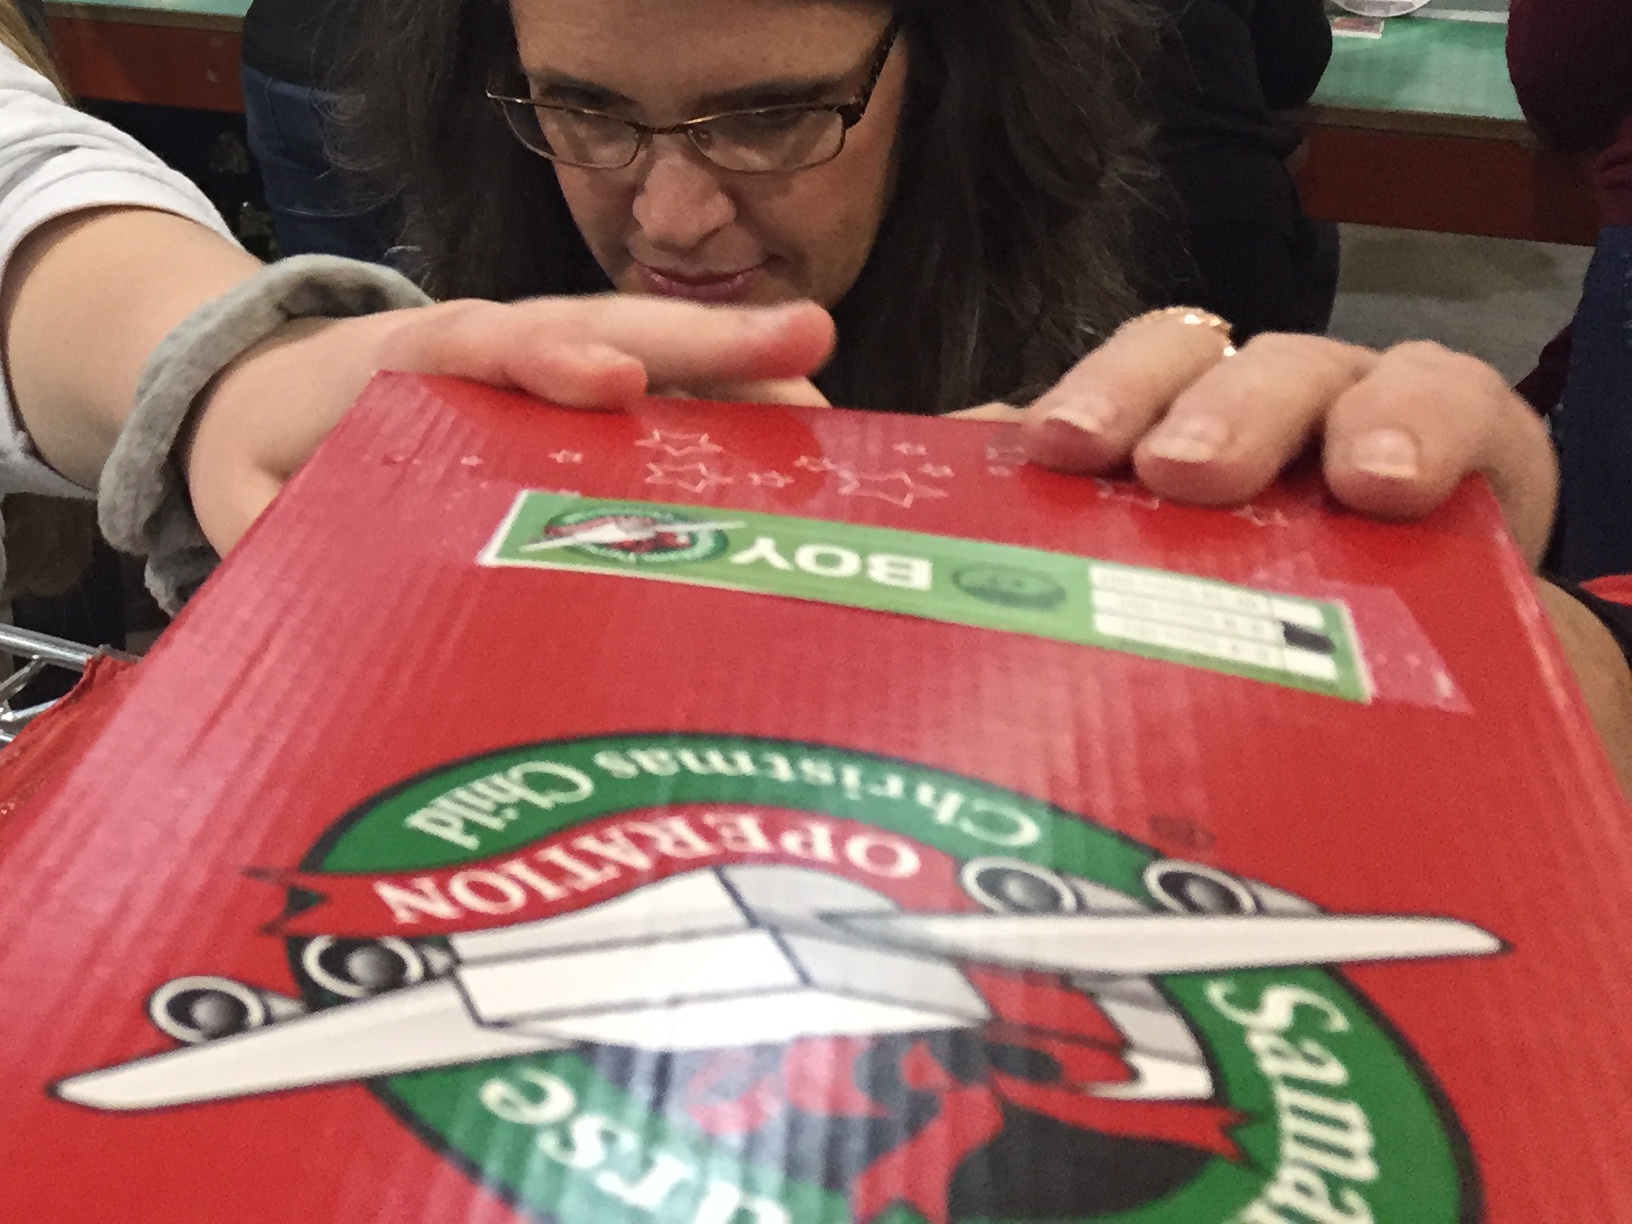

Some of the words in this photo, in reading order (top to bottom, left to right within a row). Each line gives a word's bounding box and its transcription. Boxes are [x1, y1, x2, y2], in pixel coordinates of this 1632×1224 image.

[729, 536, 933, 591] BOY
[406, 759, 595, 852] Child
[594, 747, 1042, 849] Christmas
[373, 810, 921, 926] OPERATION
